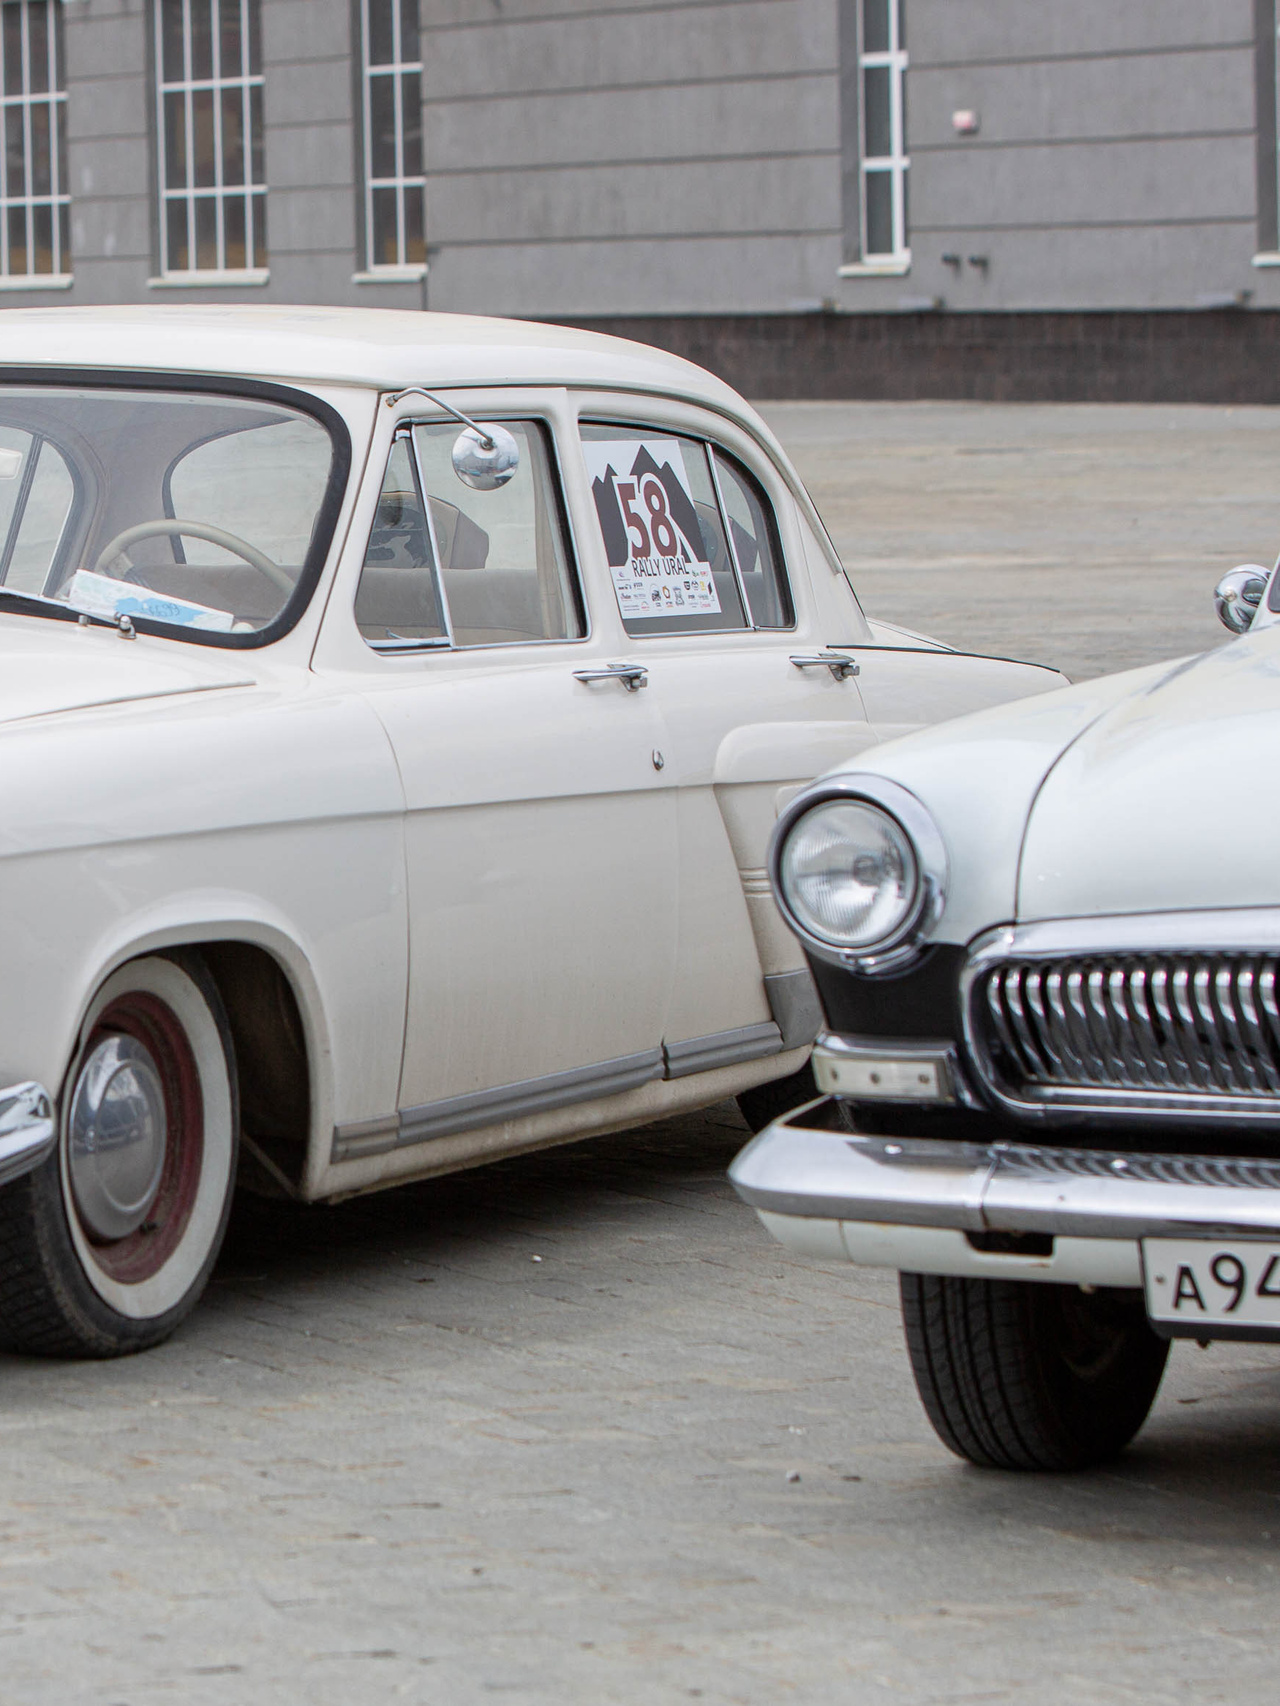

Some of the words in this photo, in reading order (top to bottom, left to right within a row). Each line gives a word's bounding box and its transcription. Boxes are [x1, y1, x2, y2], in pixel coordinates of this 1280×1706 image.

[616, 480, 678, 559] 58
[631, 558, 662, 577] RALLY
[662, 557, 690, 576] URAL
